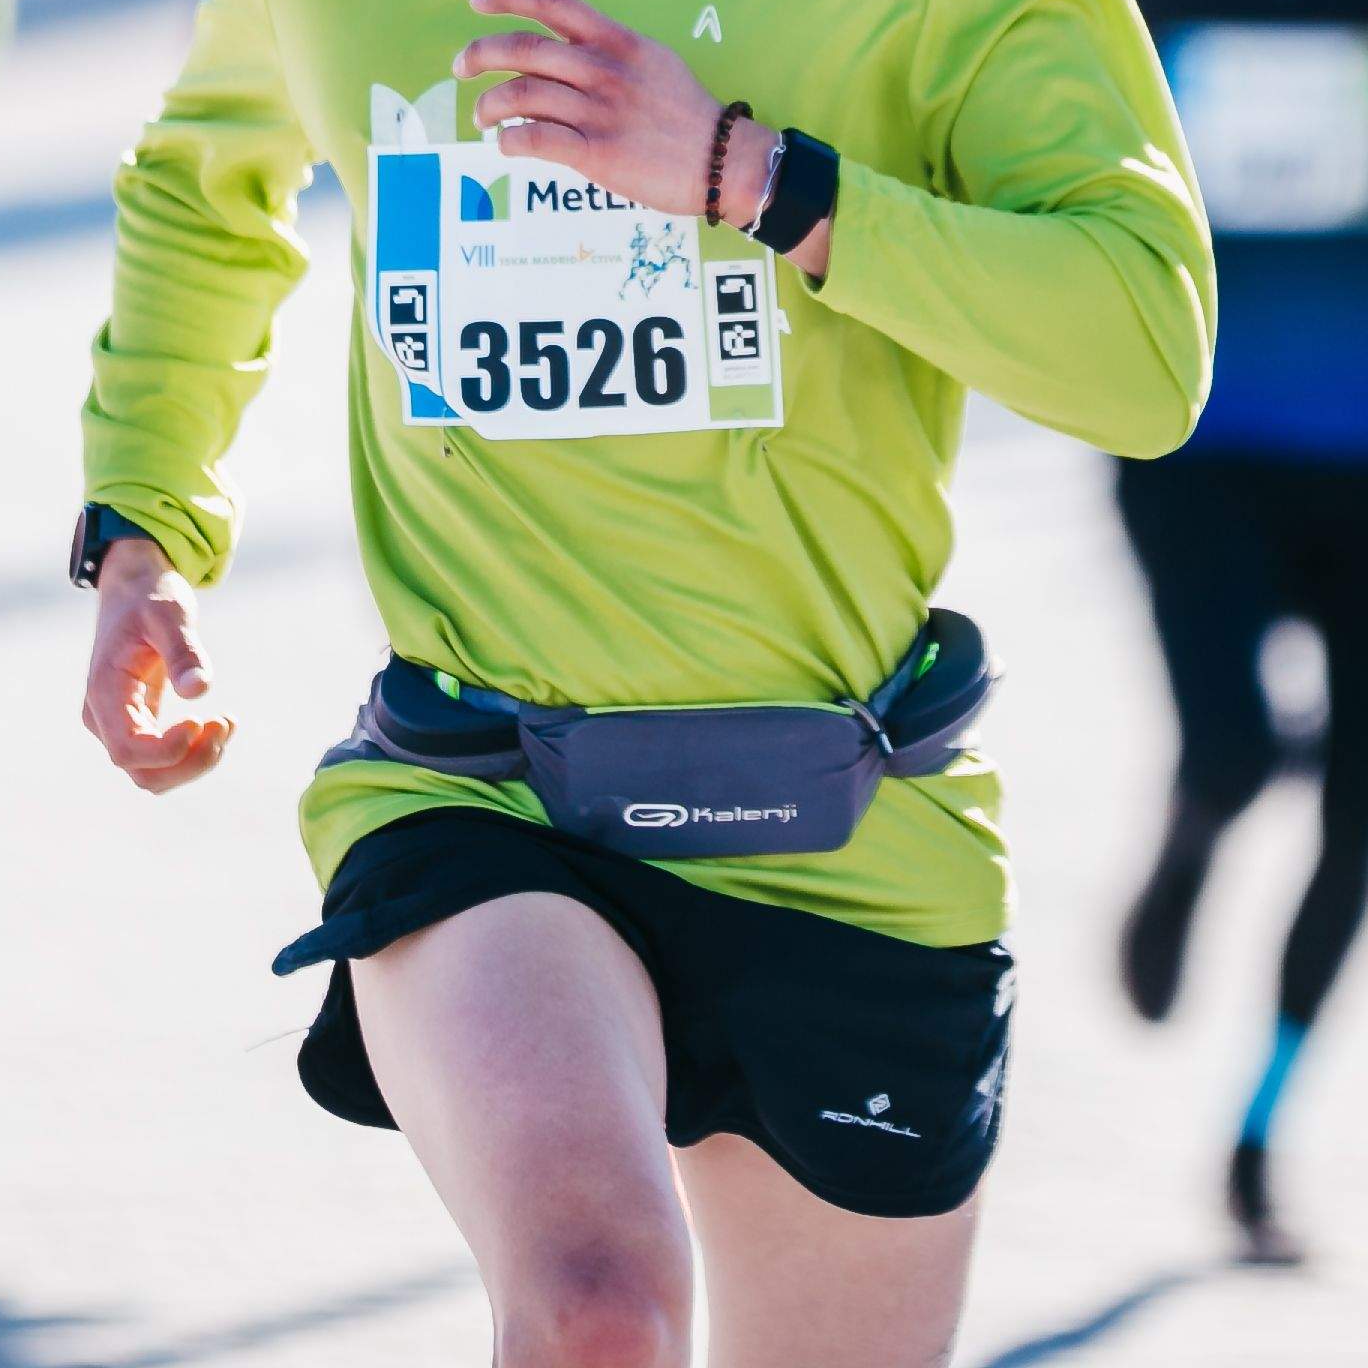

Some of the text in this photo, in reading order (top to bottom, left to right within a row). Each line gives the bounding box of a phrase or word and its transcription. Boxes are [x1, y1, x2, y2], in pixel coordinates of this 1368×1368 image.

[460, 245, 495, 267] VIII
[532, 254, 577, 265] MADRID
[460, 316, 687, 412] 3526
[692, 803, 798, 824] Kalenji
[820, 1109, 922, 1138] RONHILL
